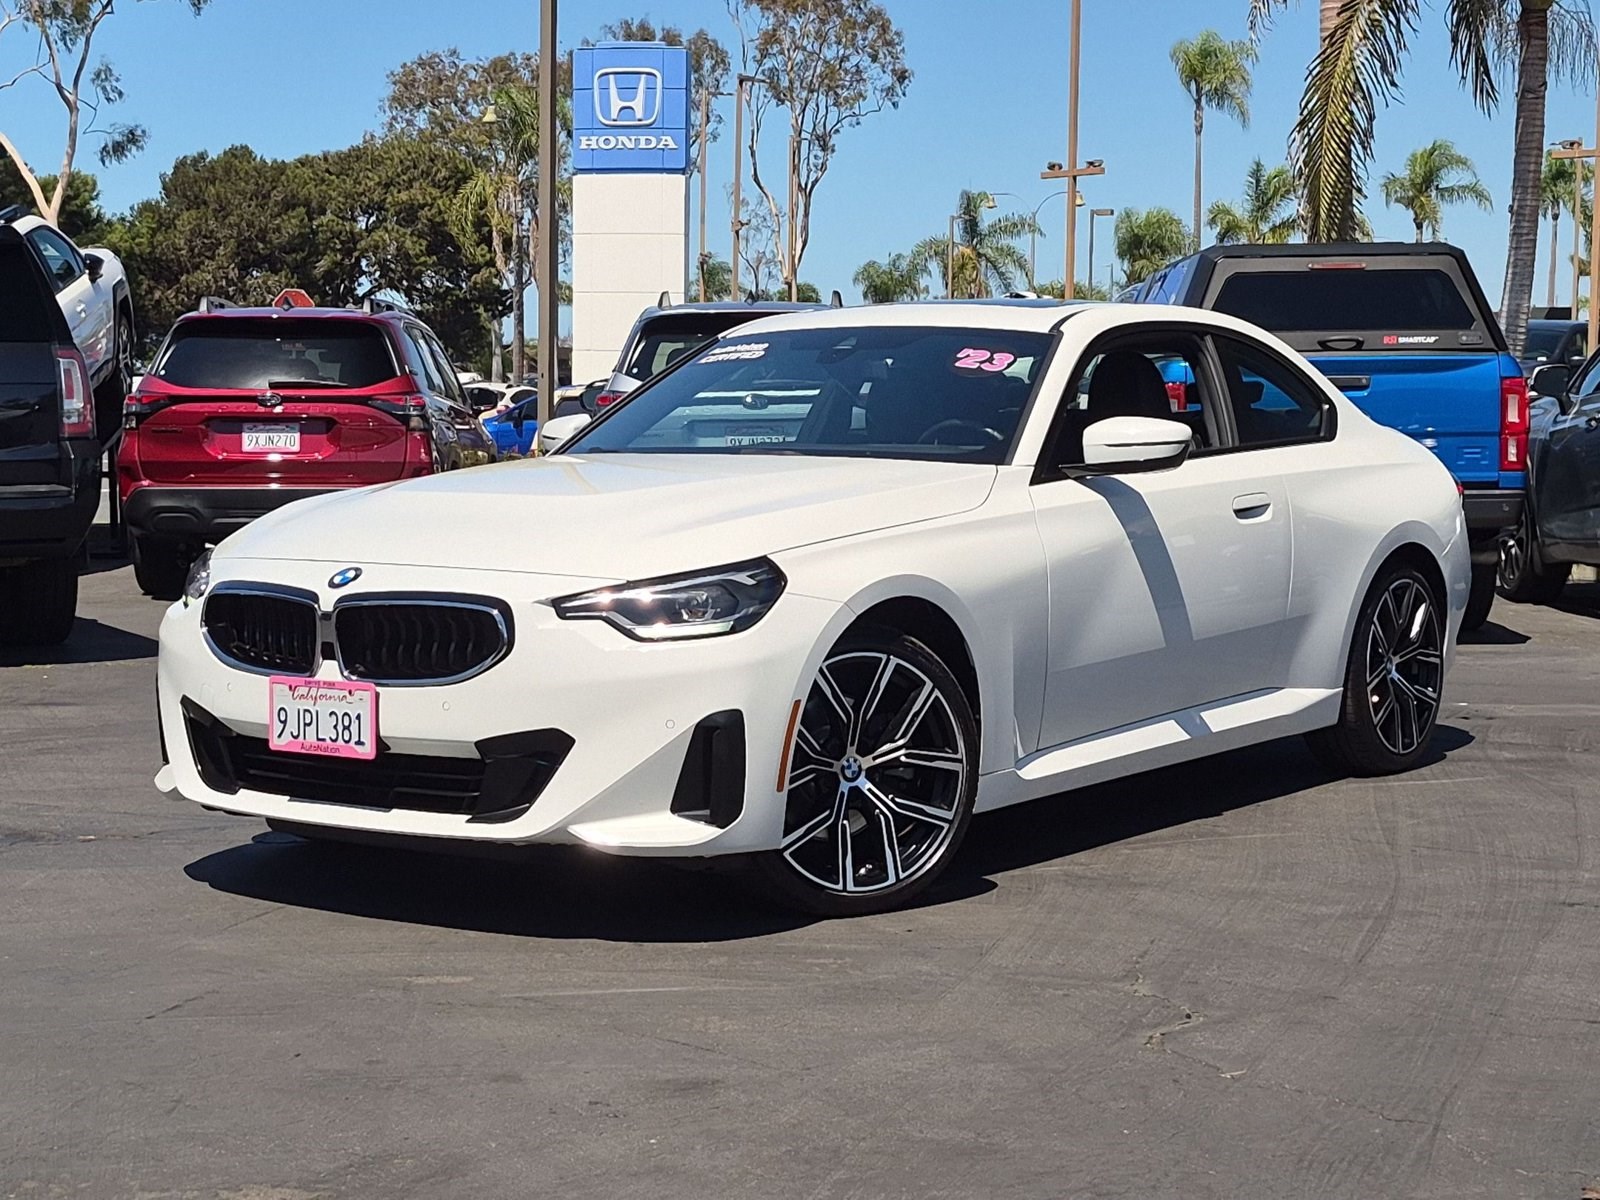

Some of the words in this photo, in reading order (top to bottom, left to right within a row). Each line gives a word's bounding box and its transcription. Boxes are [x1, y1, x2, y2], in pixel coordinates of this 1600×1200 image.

[579, 136, 678, 149] HONDA
[247, 434, 296, 447] 9XJN270
[292, 685, 354, 706] California
[277, 707, 365, 747] 9JPL381
[300, 743, 340, 754] AutoNation
